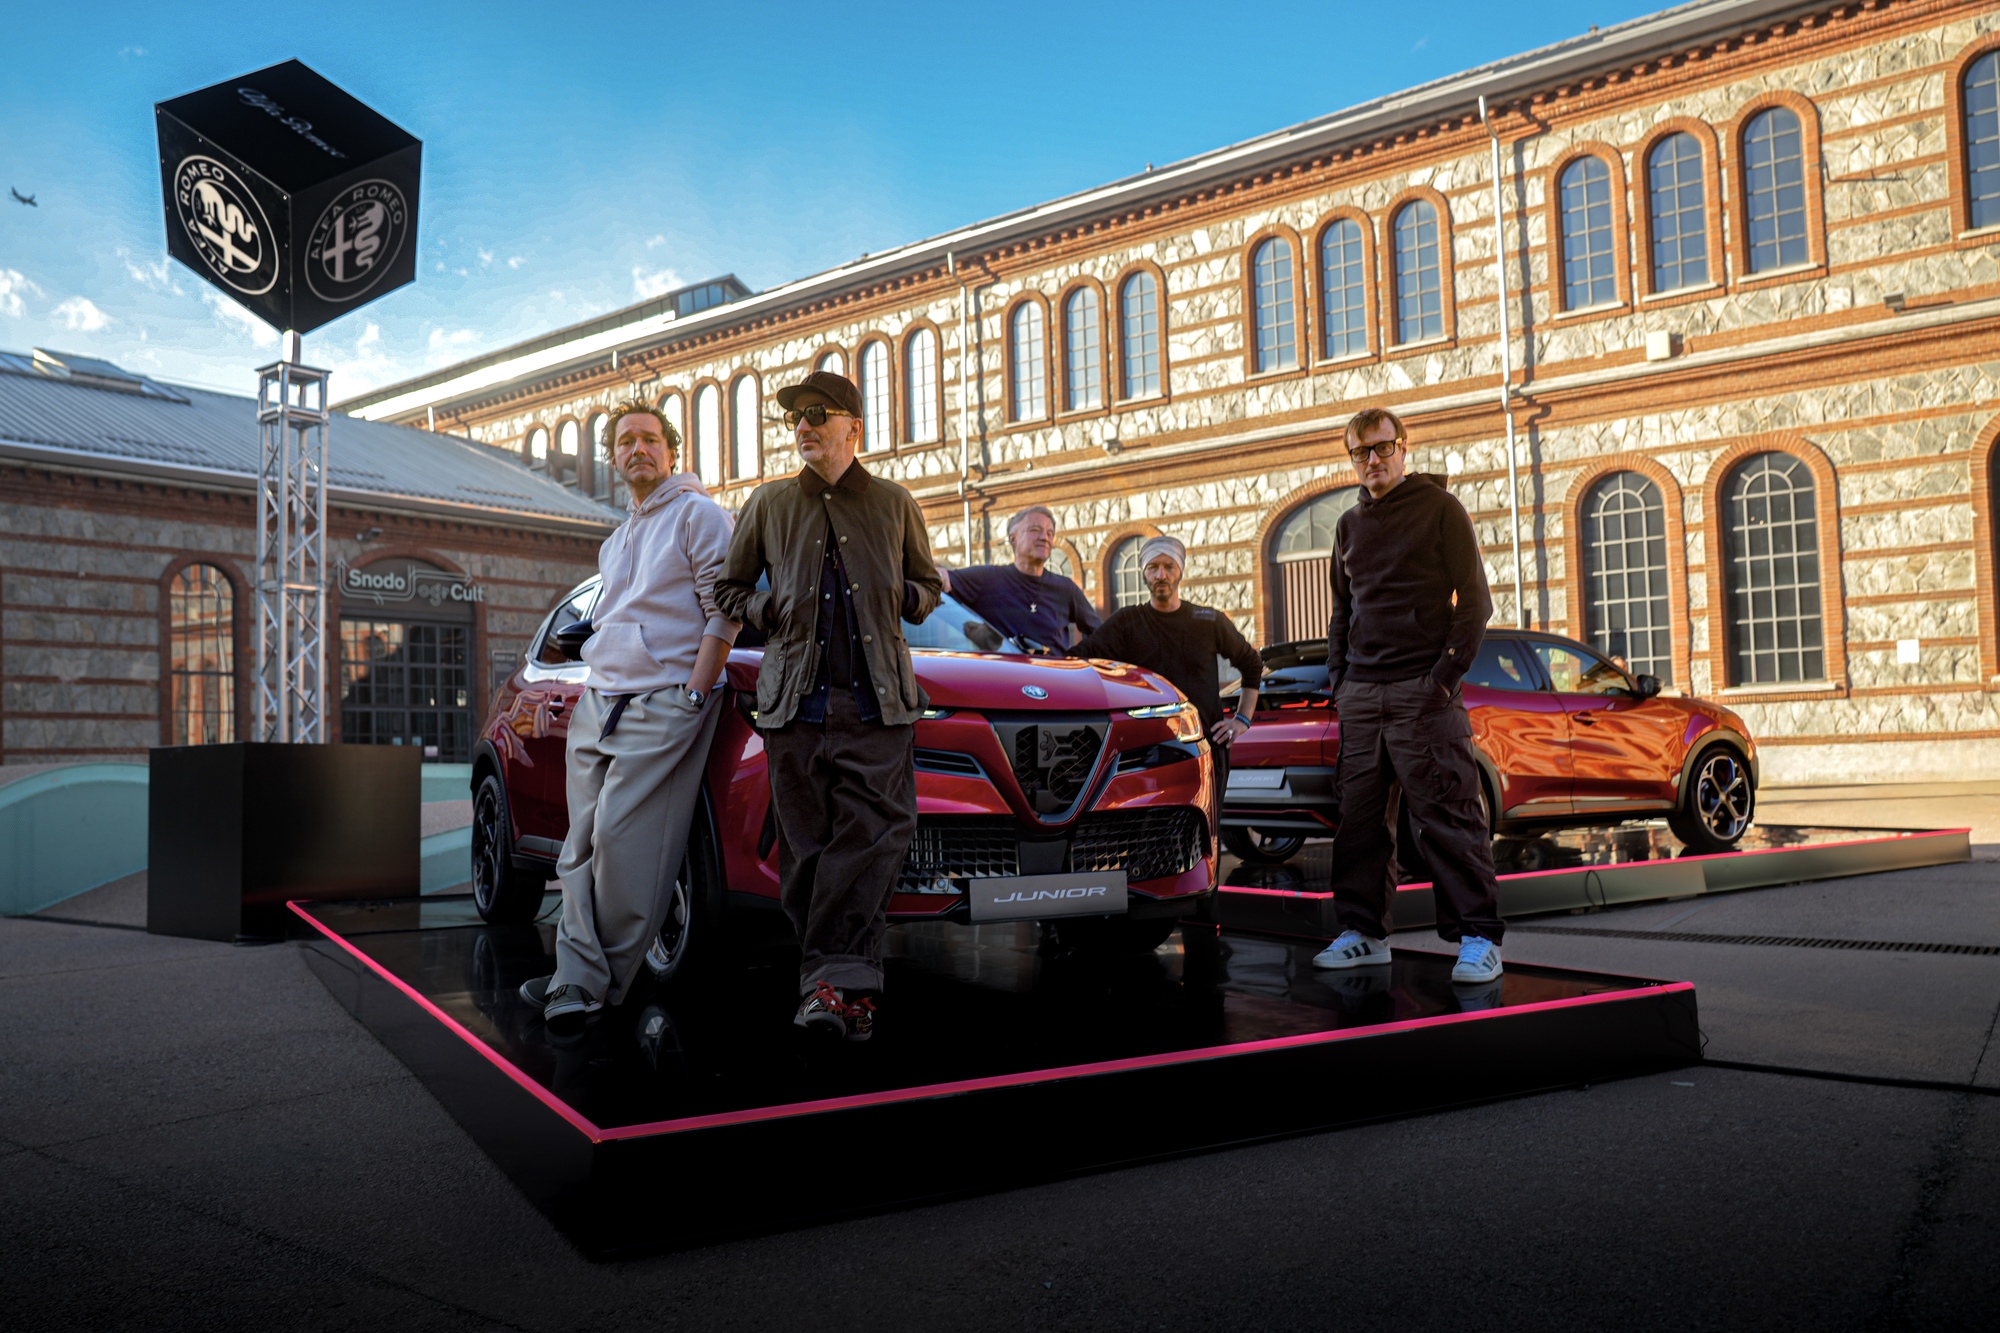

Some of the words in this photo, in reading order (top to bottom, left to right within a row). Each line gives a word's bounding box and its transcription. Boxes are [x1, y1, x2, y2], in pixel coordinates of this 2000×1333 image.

[180, 163, 224, 206] ROMEO
[311, 205, 343, 259] ALFA
[353, 186, 403, 225] ROMEO
[188, 219, 229, 274] ALFA
[349, 569, 406, 590] Snodo
[450, 584, 484, 602] Cult
[993, 886, 1107, 903] JUNIOR
